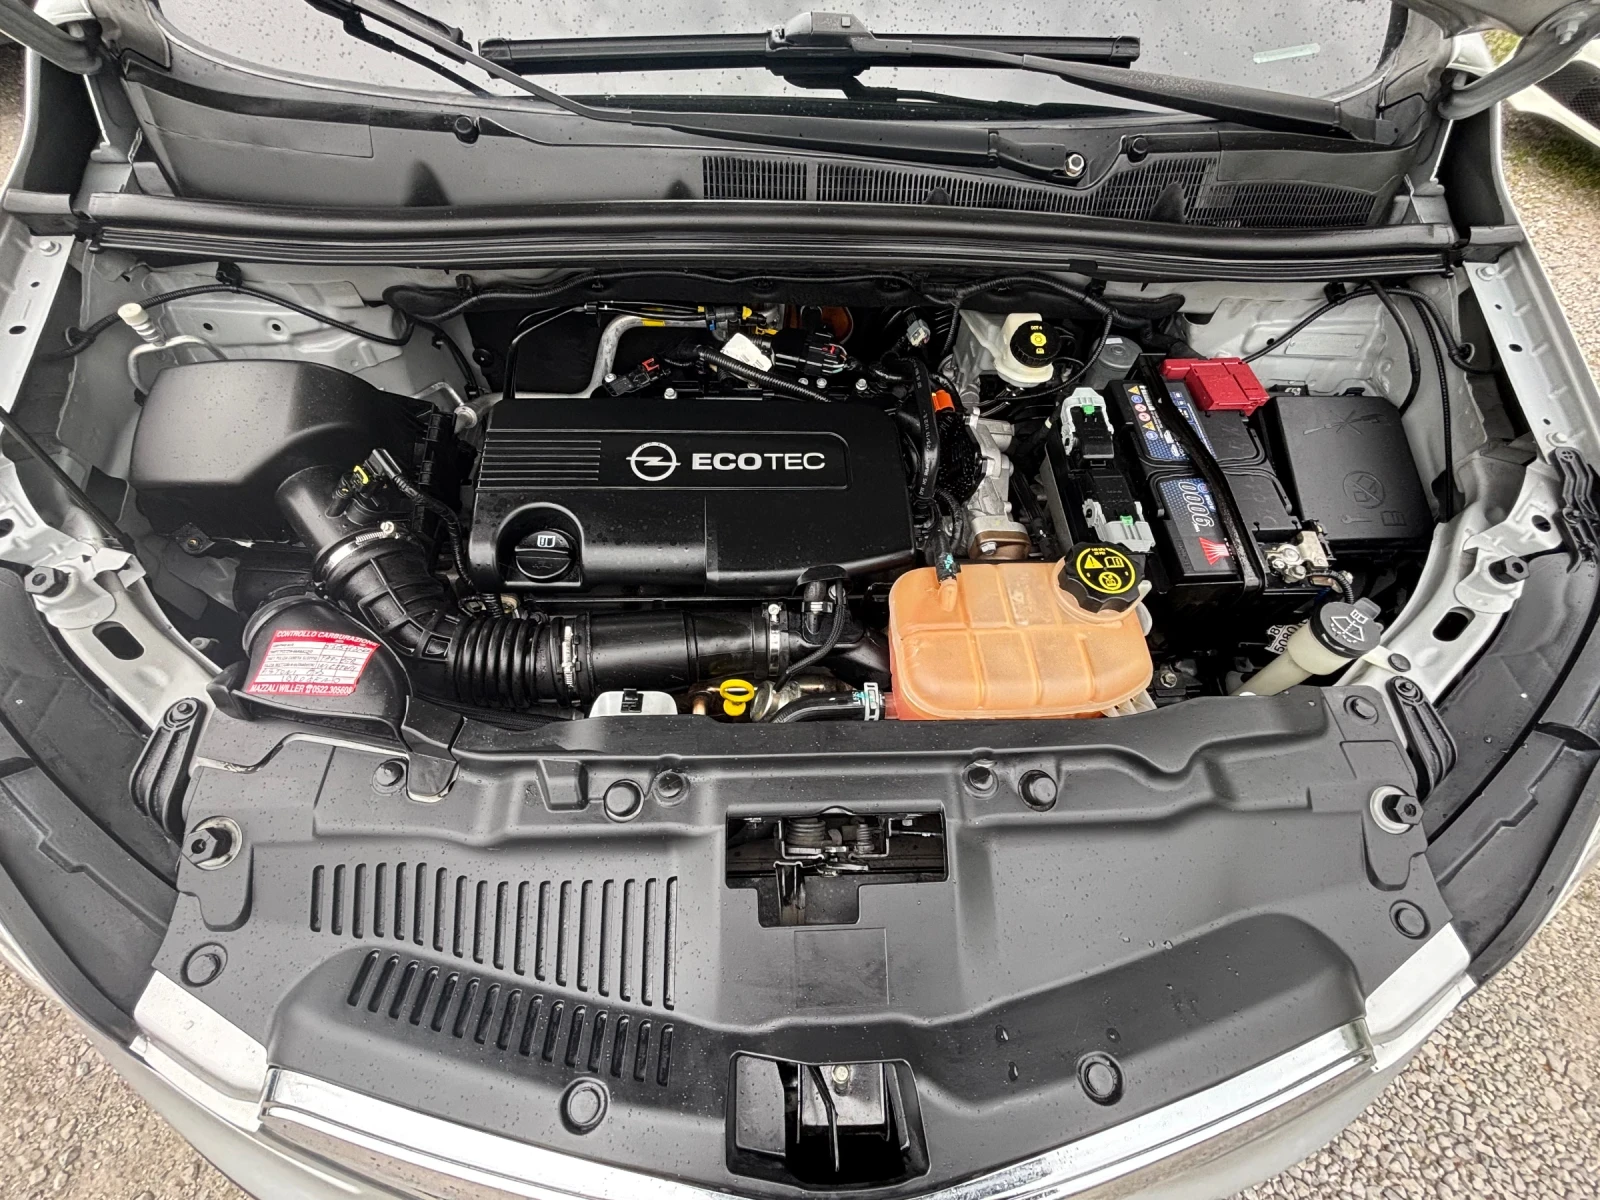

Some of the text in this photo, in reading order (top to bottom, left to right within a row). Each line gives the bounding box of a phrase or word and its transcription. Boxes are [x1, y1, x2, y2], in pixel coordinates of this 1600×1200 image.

[691, 452, 826, 471] ECOTEC
[276, 630, 381, 647] CONTROLLO CARBURAZIONE
[279, 684, 305, 693] WILLER
